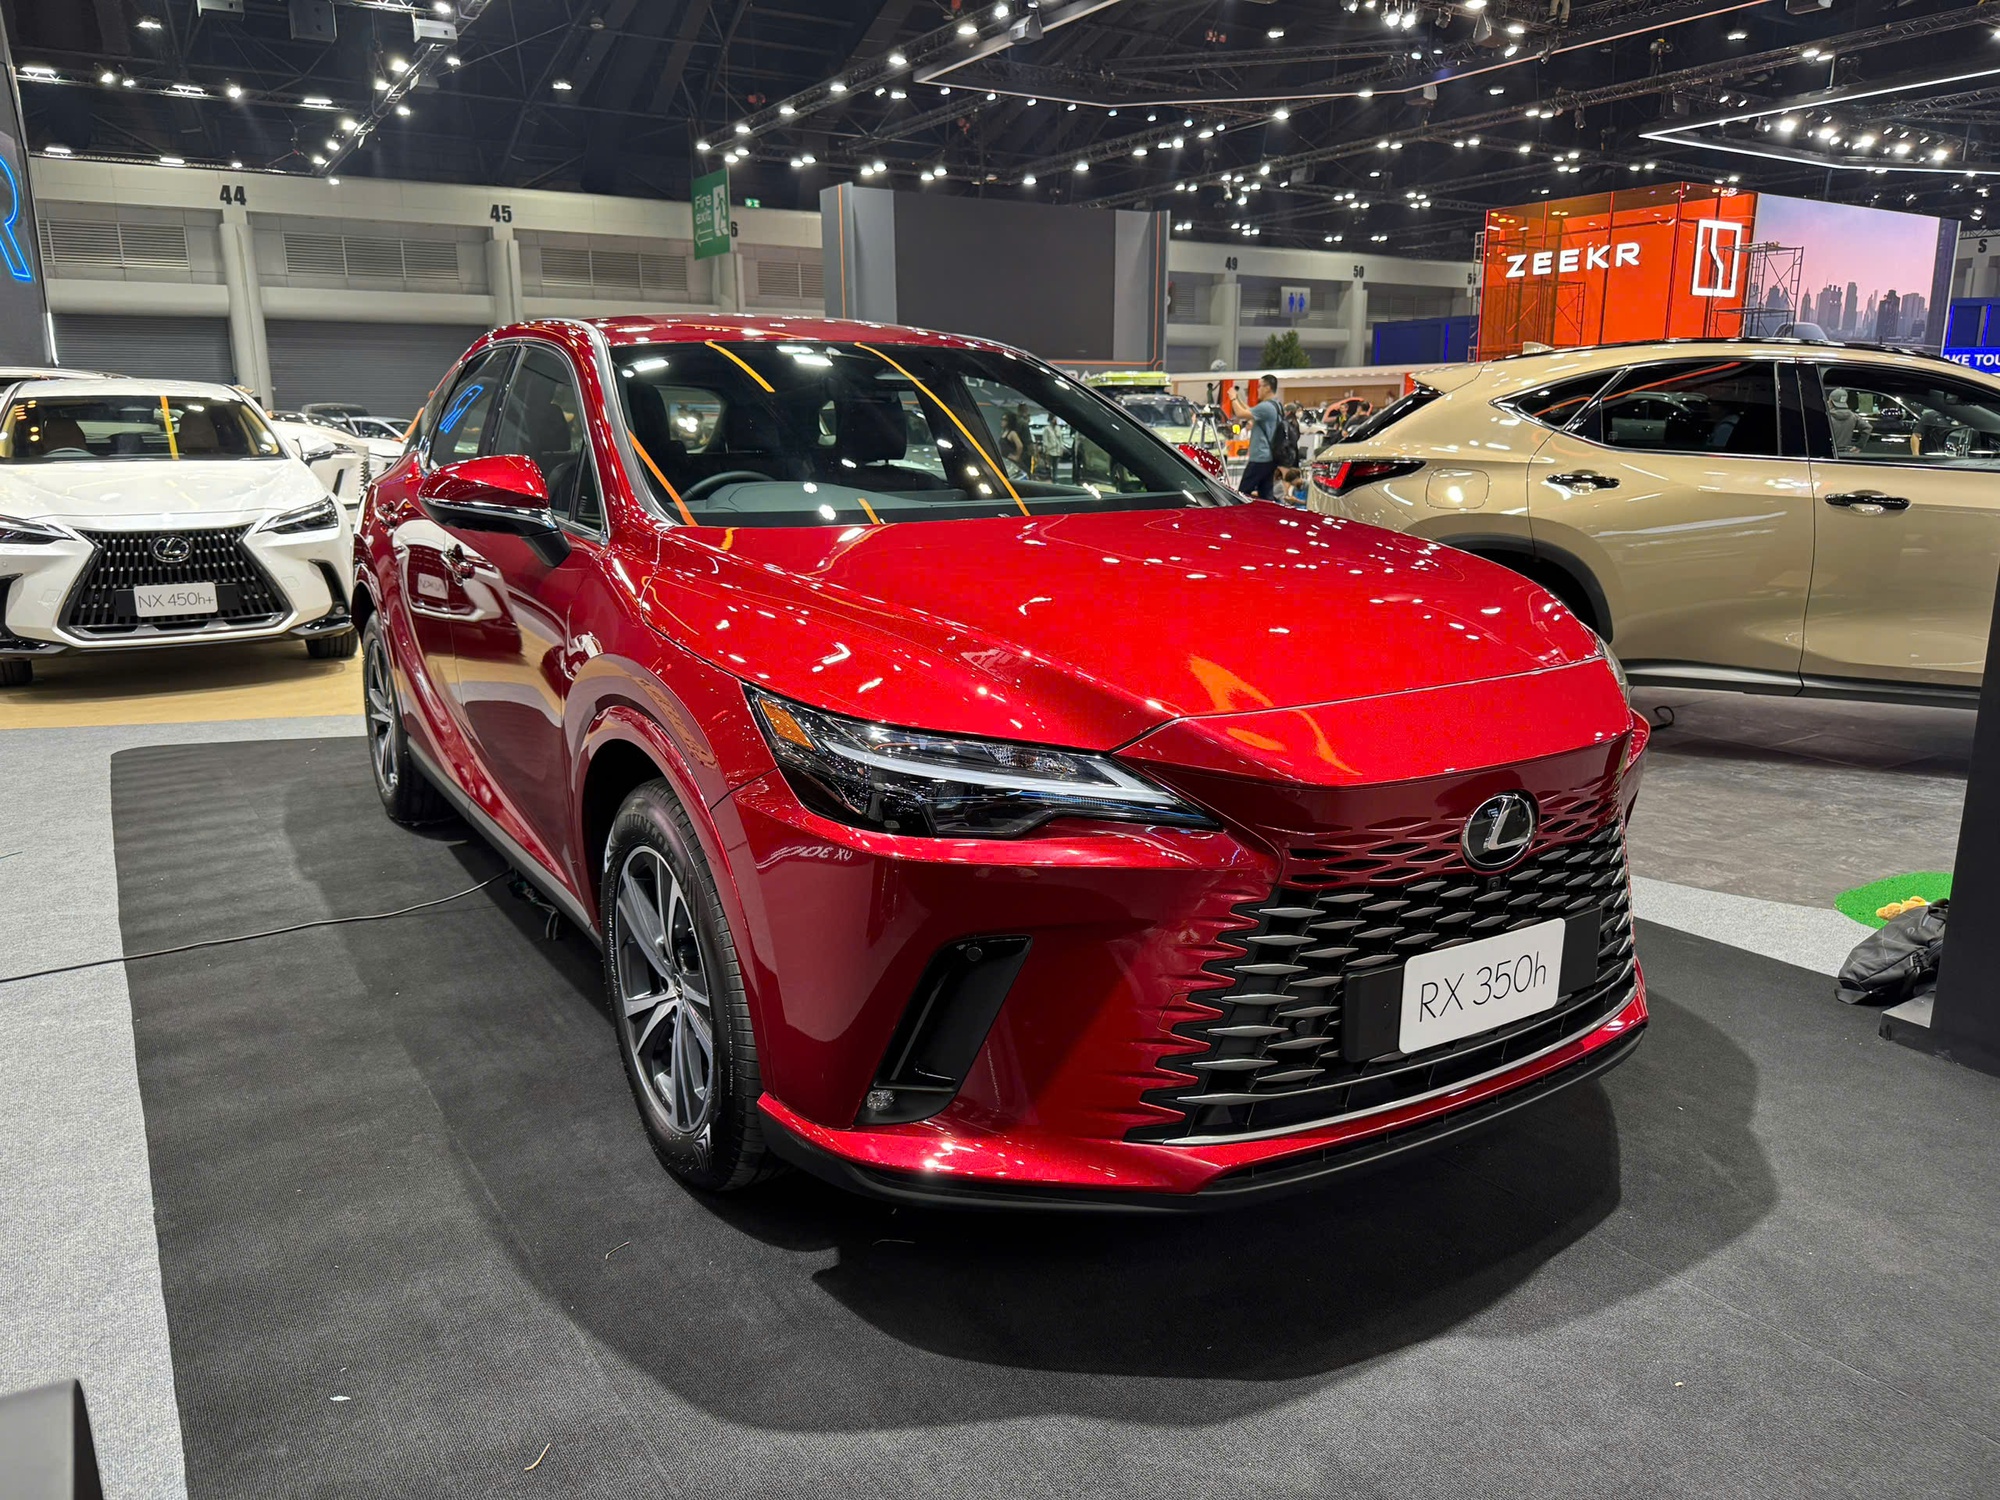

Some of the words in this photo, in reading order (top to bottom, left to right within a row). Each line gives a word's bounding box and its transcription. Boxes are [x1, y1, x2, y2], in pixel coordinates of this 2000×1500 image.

[220, 185, 246, 206] 44
[695, 194, 712, 210] Fire
[490, 204, 512, 223] 45
[696, 208, 712, 225] exit
[730, 221, 738, 237] 6
[1225, 256, 1238, 271] 49
[1505, 242, 1640, 278] ZEEKR
[1353, 265, 1364, 279] 50
[138, 594, 164, 608] NX
[167, 592, 214, 606] 450h+
[625, 813, 677, 863] DUNLOP
[1420, 973, 1465, 1022] RX
[1472, 951, 1548, 1006] 350h
